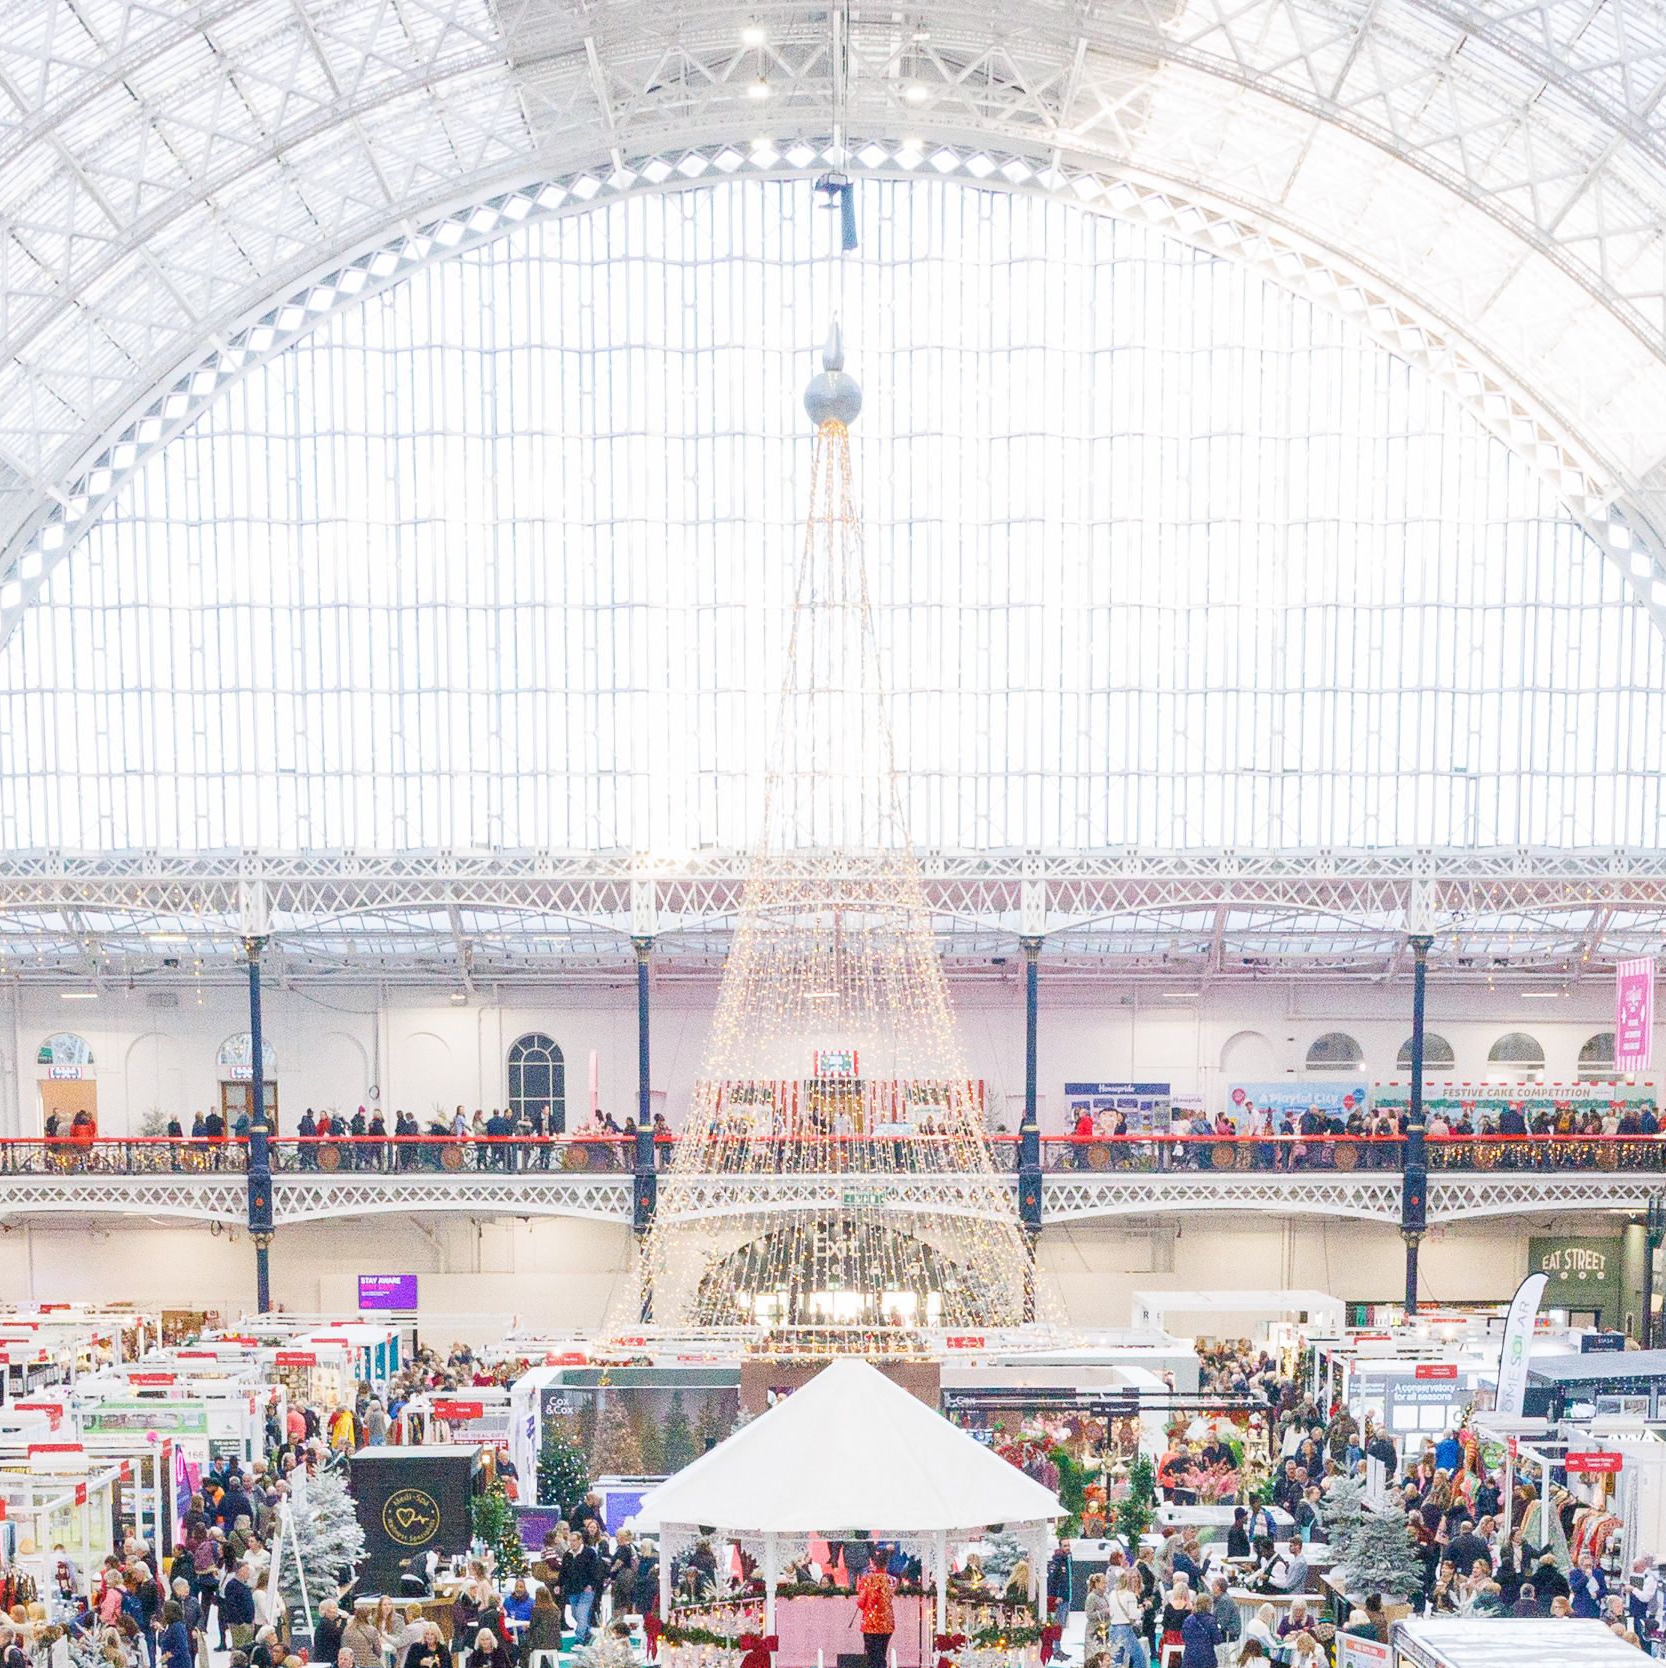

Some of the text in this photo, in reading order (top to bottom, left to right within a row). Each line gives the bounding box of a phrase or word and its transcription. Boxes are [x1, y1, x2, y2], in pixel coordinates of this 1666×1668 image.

[1442, 1088, 1590, 1098] FESTIVE CAKE COMPETITION
[814, 1233, 861, 1258] Exit
[1542, 1248, 1607, 1271] EAT STREET
[549, 1397, 570, 1406] Cox
